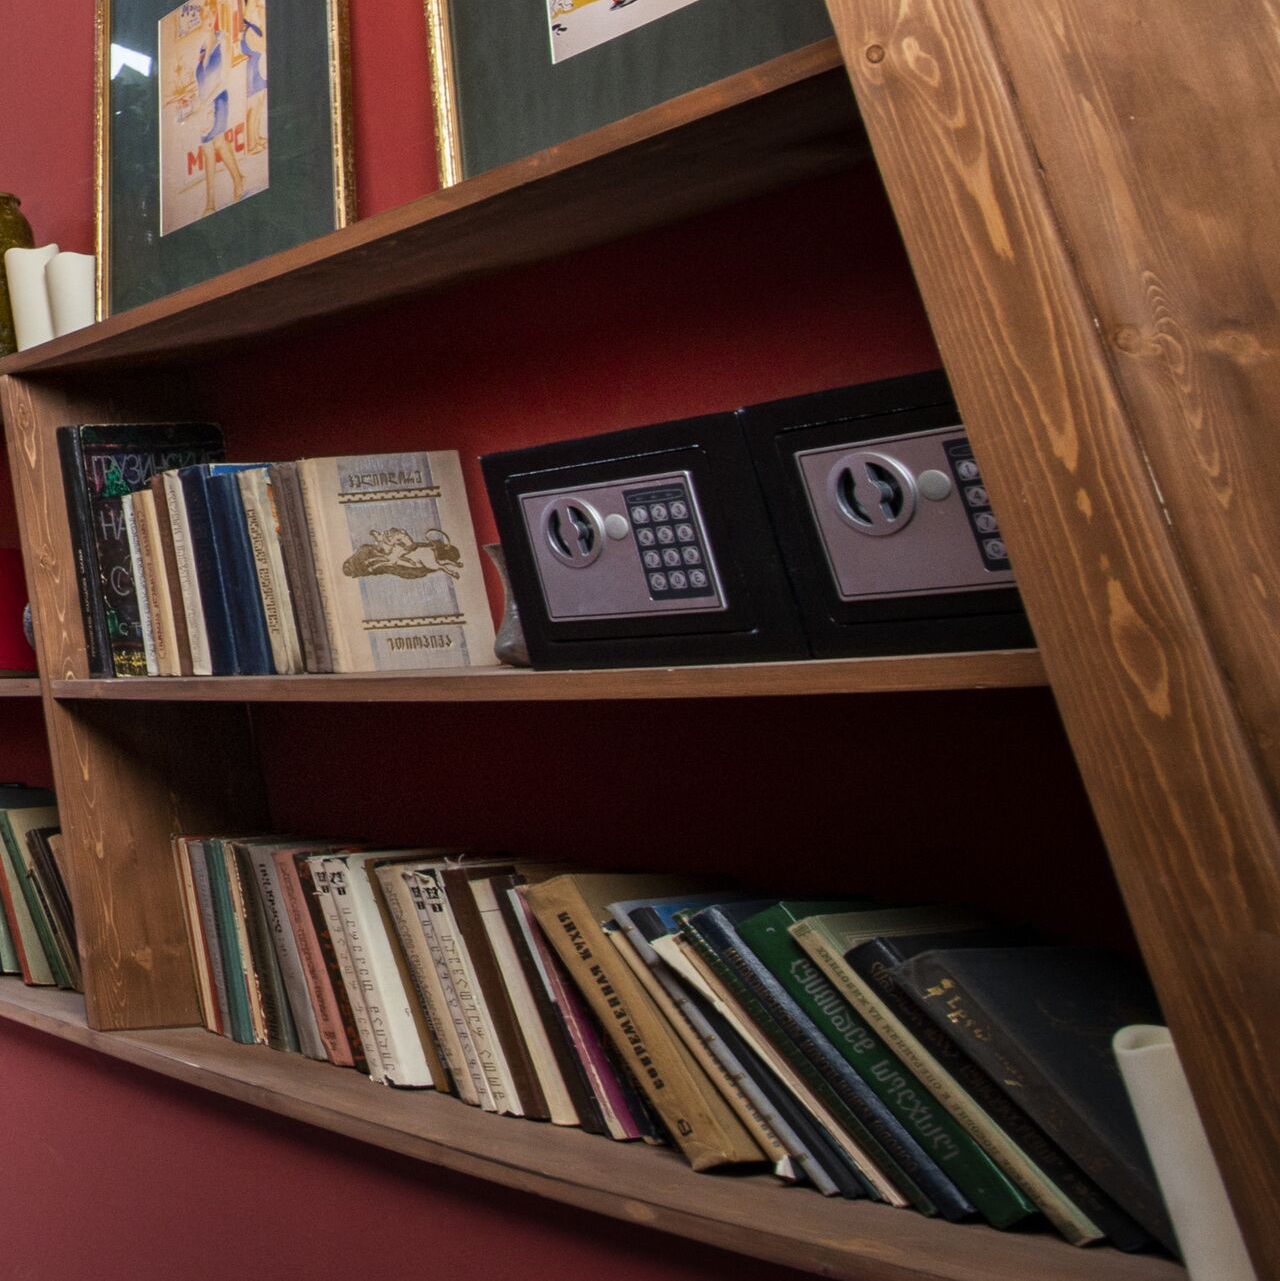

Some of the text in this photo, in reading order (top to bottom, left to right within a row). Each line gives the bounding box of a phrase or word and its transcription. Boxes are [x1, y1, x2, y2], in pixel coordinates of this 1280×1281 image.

[187, 123, 245, 175] МРС
[348, 470, 423, 487] ჰელიოდორე
[386, 634, 455, 651] ეთიოპიკა
[555, 908, 668, 1091] СОВРЕМЕННАЯ КУХНЯ
[813, 943, 874, 1008] ЖИВОТНЫХ
[783, 952, 965, 1165] საოჯახო მედიცინა
[880, 1020, 945, 1092] ОПЕРАЦИЯМ
